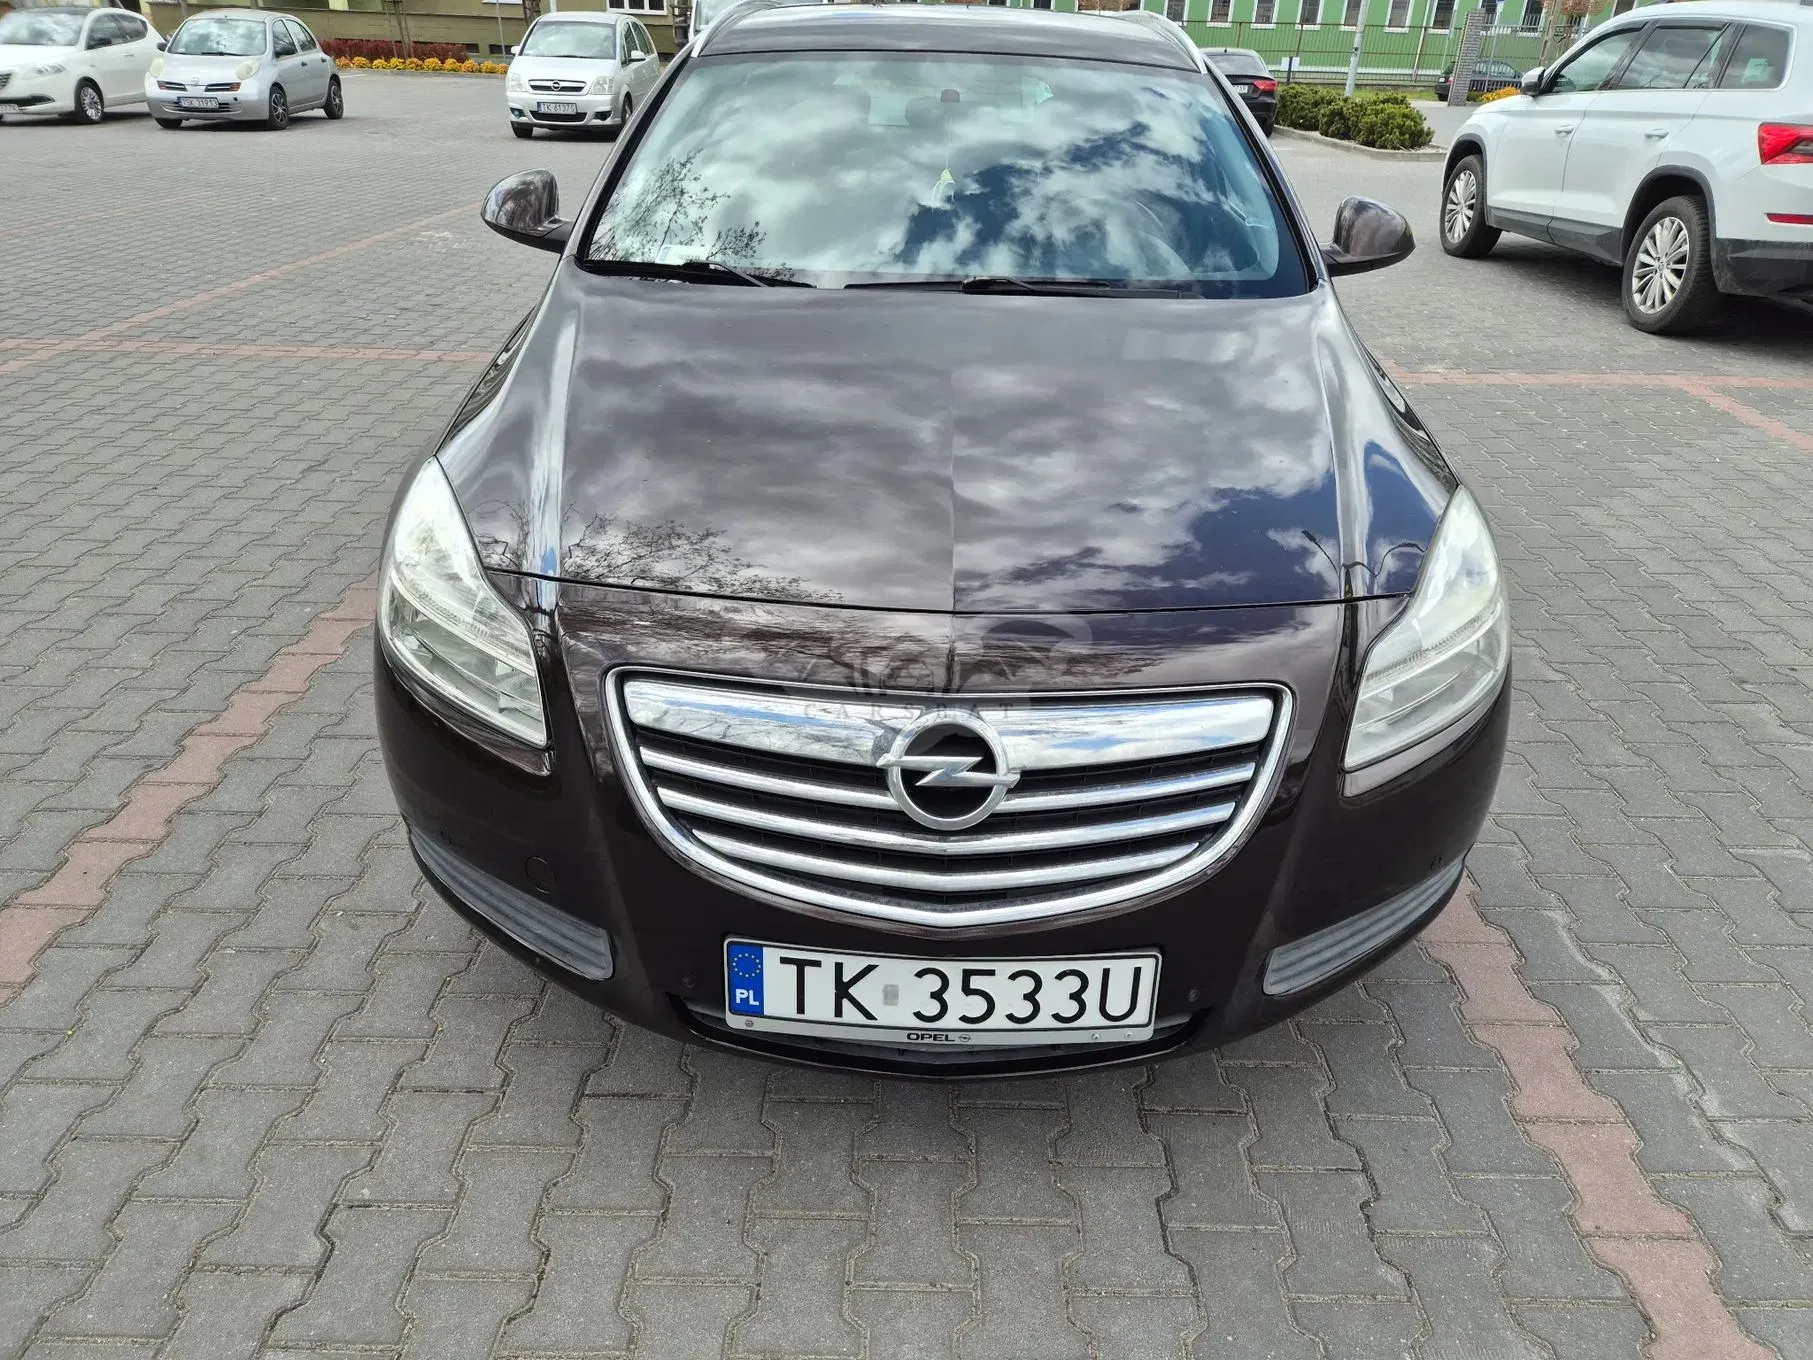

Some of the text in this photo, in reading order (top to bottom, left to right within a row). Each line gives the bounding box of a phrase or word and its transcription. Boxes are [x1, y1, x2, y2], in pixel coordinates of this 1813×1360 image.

[735, 987, 760, 1006] PL
[779, 956, 1142, 1025] TK 3533U
[906, 1032, 956, 1042] OPEL
